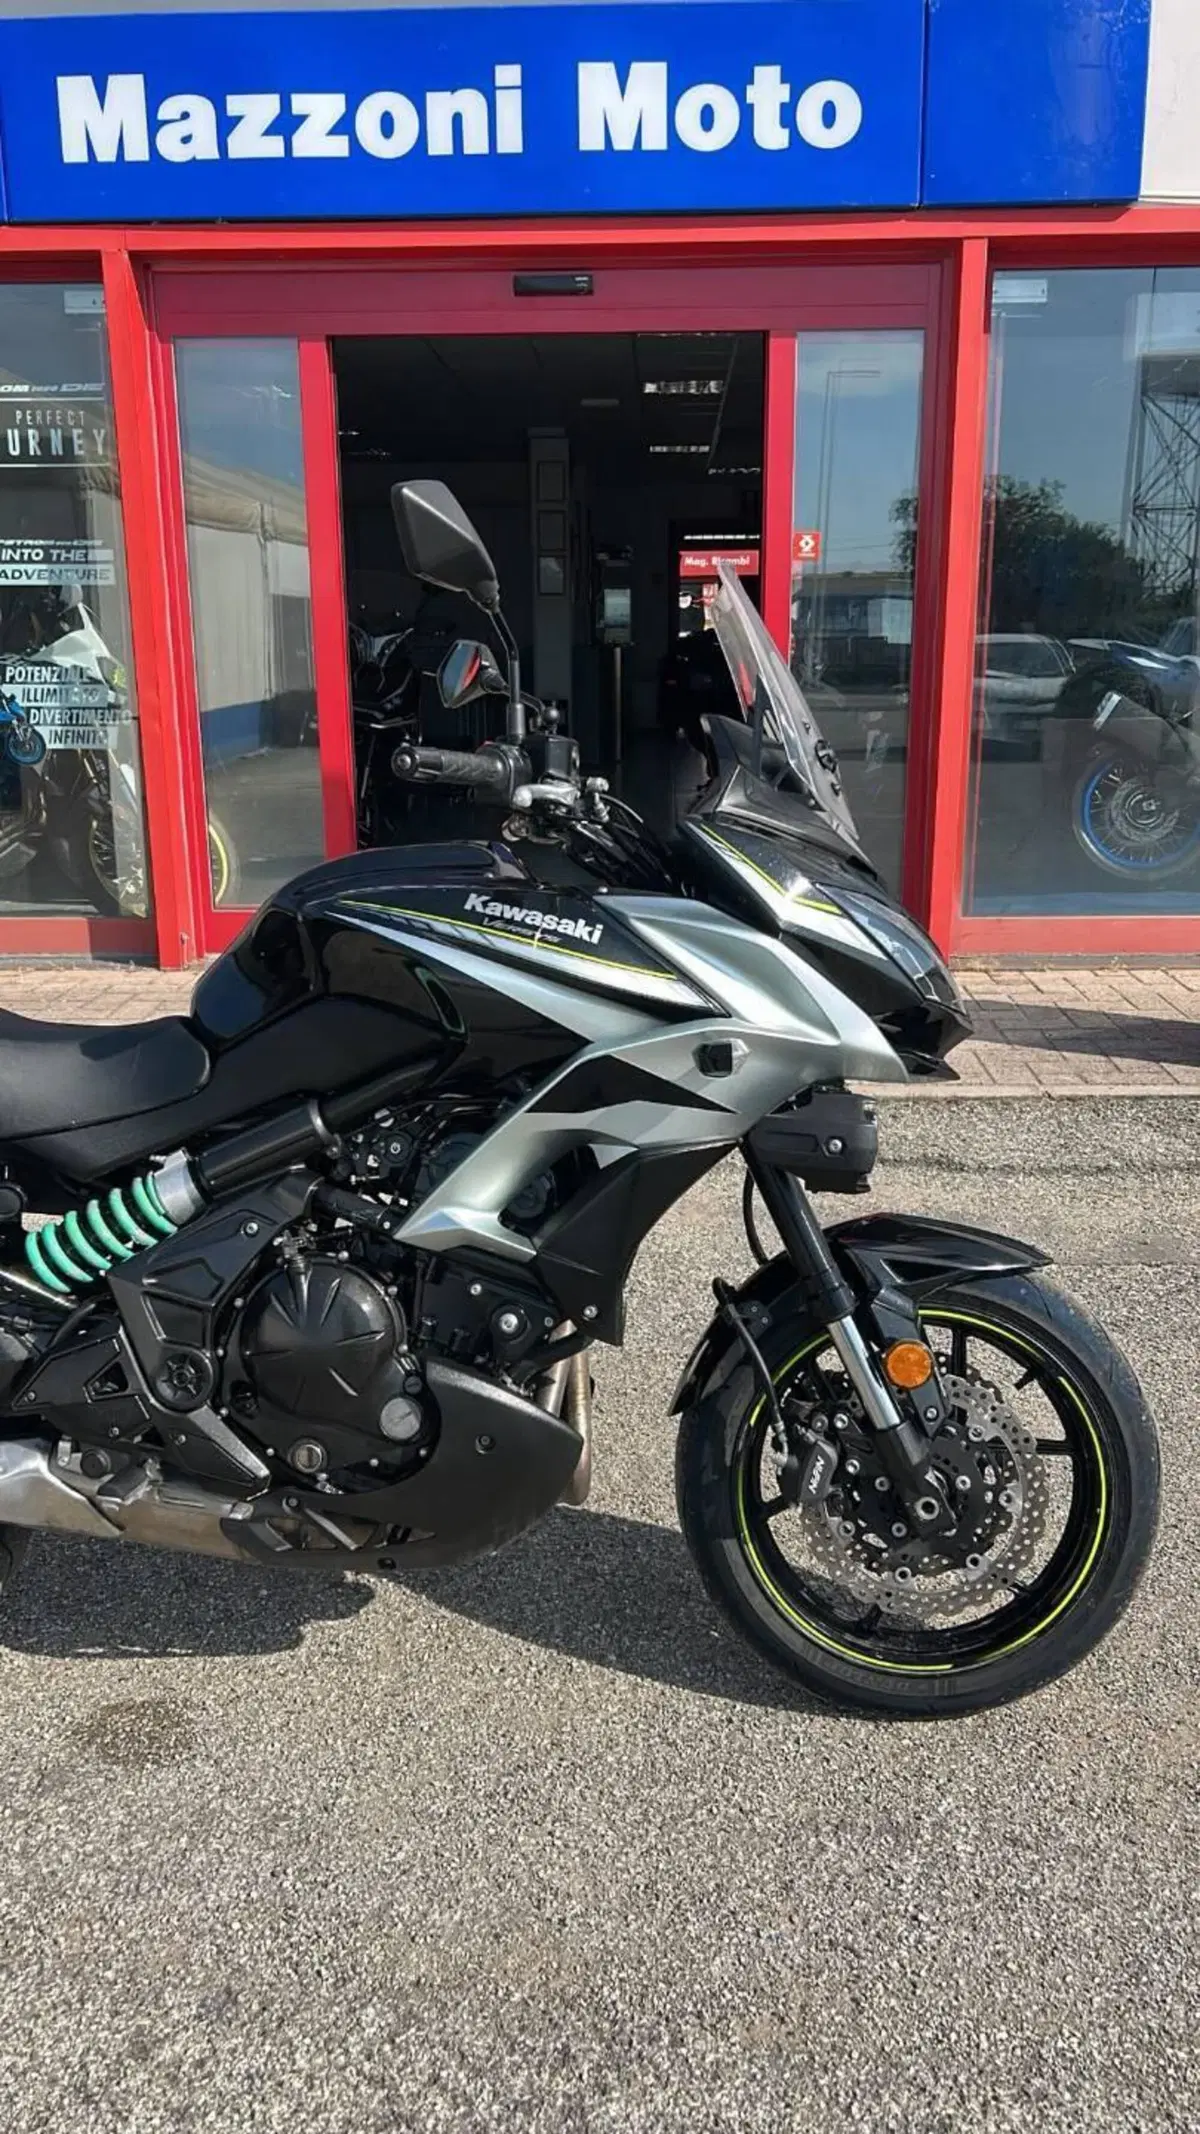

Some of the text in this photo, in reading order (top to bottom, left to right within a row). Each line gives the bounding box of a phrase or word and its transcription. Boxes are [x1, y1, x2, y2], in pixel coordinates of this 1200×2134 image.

[58, 63, 861, 162] Mazzoni Moto
[16, 410, 85, 426] PERFECT
[7, 428, 105, 456] URNEY
[1, 548, 87, 562] INTO THE
[684, 557, 709, 568] Mag.
[0, 568, 110, 581] ADVENTURE
[30, 709, 133, 725] DIVERTIMENTO
[463, 892, 604, 945] Kawasaki
